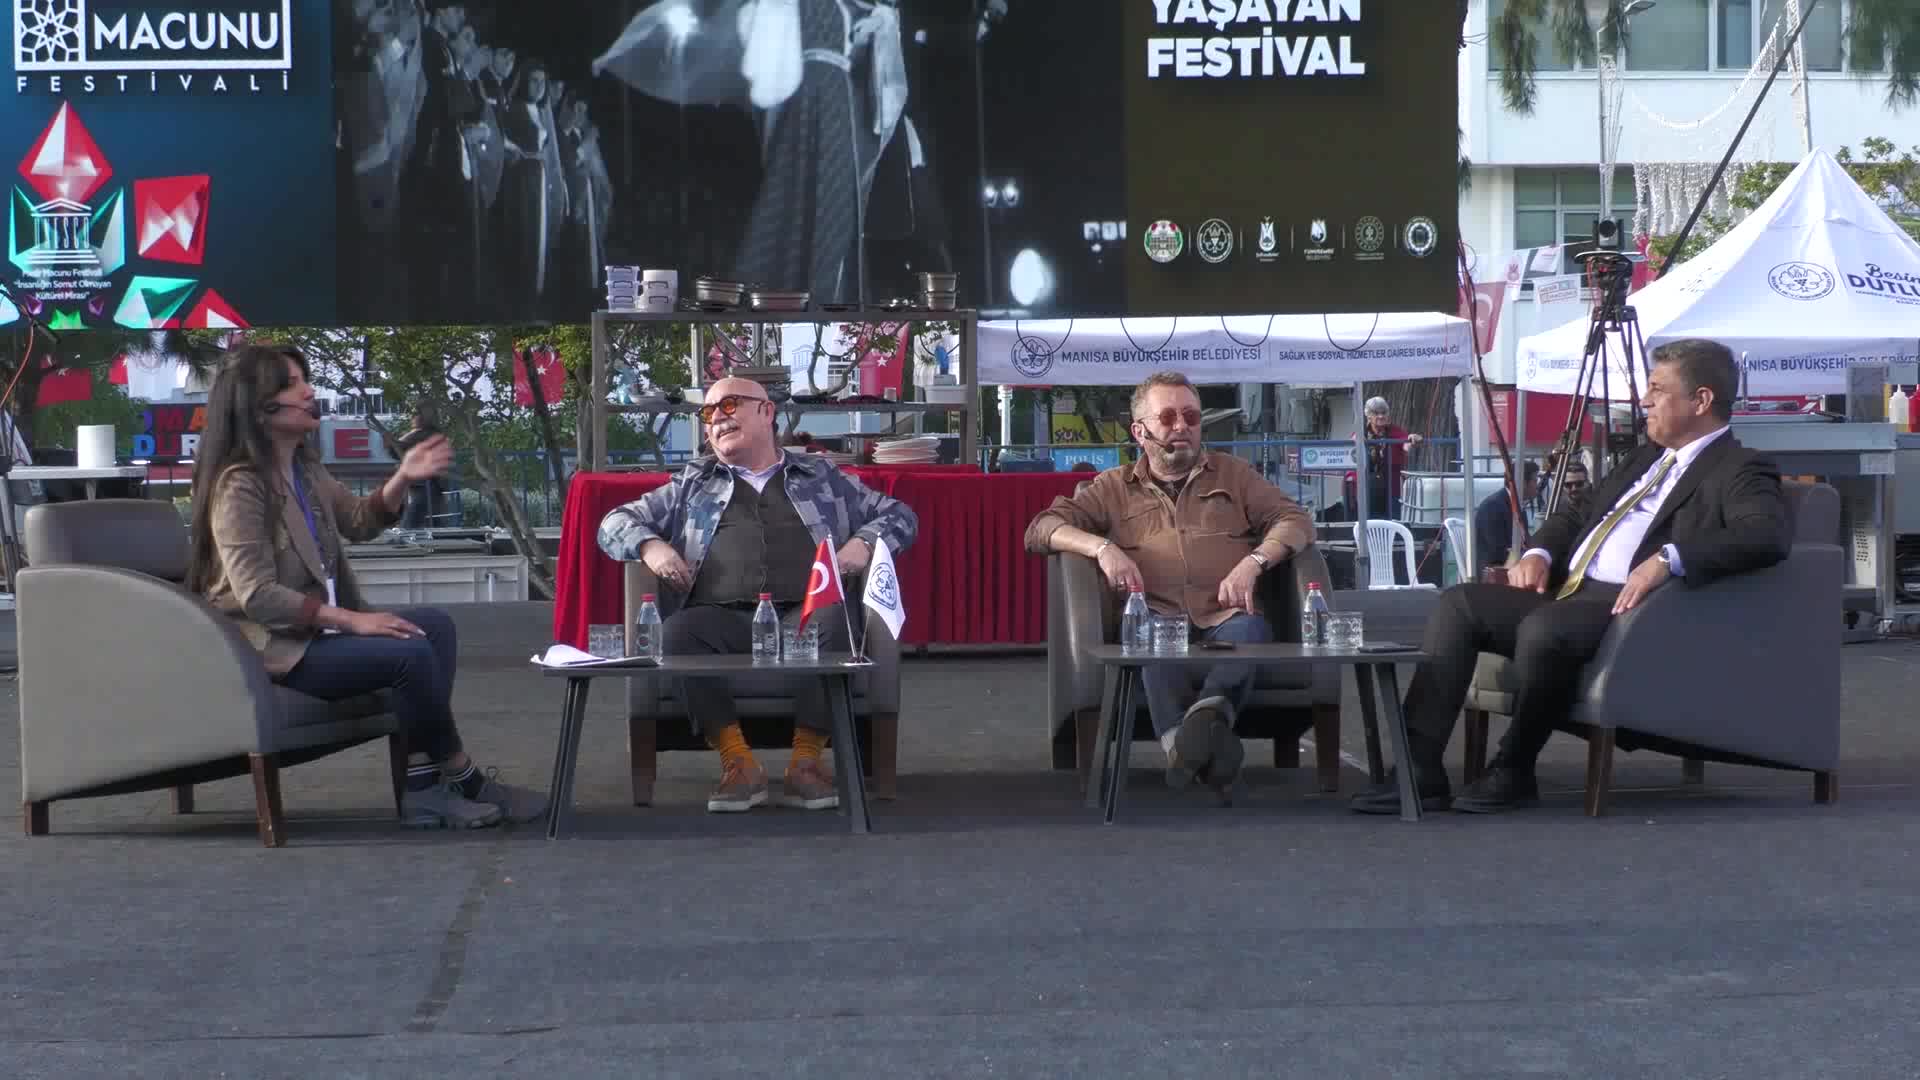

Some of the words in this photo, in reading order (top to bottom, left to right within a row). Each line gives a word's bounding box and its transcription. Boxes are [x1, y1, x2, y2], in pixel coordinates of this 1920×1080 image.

[94, 12, 278, 50] MACUNU
[1153, 0, 1361, 31] YAŞAYAN
[1147, 26, 1366, 78] FESTİVAL
[16, 71, 289, 93] FESTİVALİ
[34, 216, 90, 249] UNESCO
[1113, 346, 1189, 364] BÜYÜKŞEHİR
[1193, 346, 1261, 361] BELEDİYESİ
[1307, 351, 1317, 361] VE
[1318, 350, 1346, 360] SOSYAL
